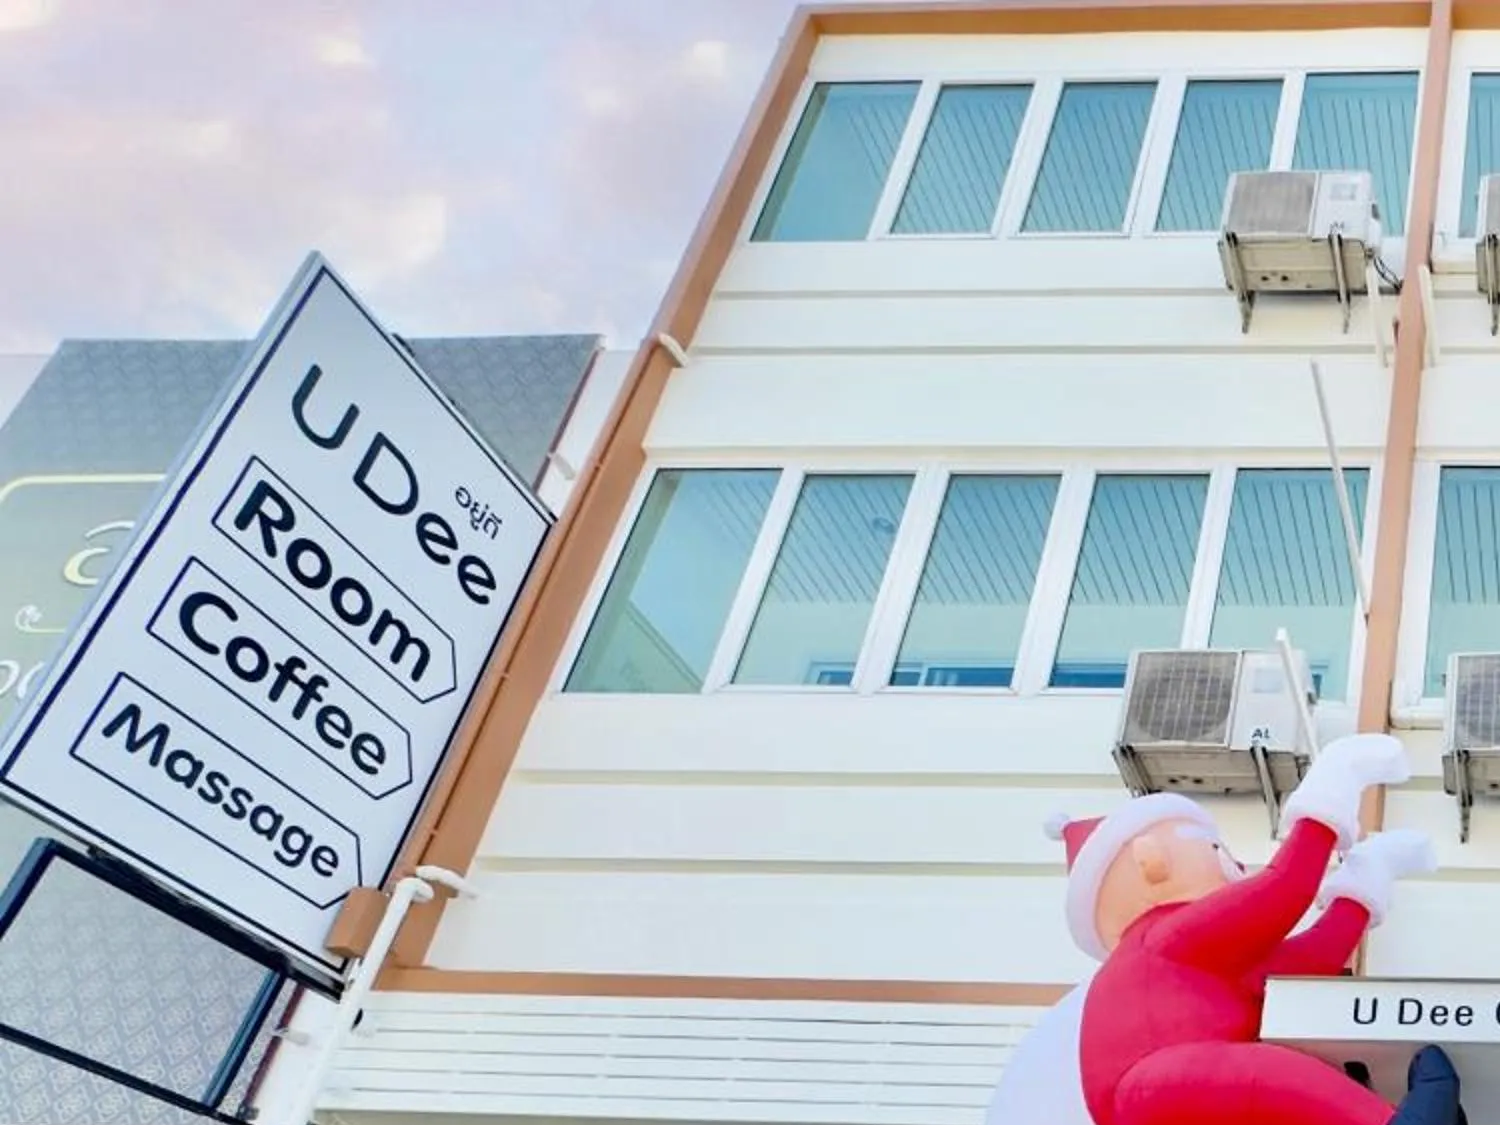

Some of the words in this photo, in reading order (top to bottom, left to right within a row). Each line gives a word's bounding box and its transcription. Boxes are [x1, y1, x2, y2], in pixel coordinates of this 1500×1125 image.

[233, 479, 432, 683] Room
[178, 591, 387, 776] Coffee
[101, 703, 340, 878] Massage
[1352, 997, 1379, 1026] U
[1397, 998, 1475, 1027] Dee
